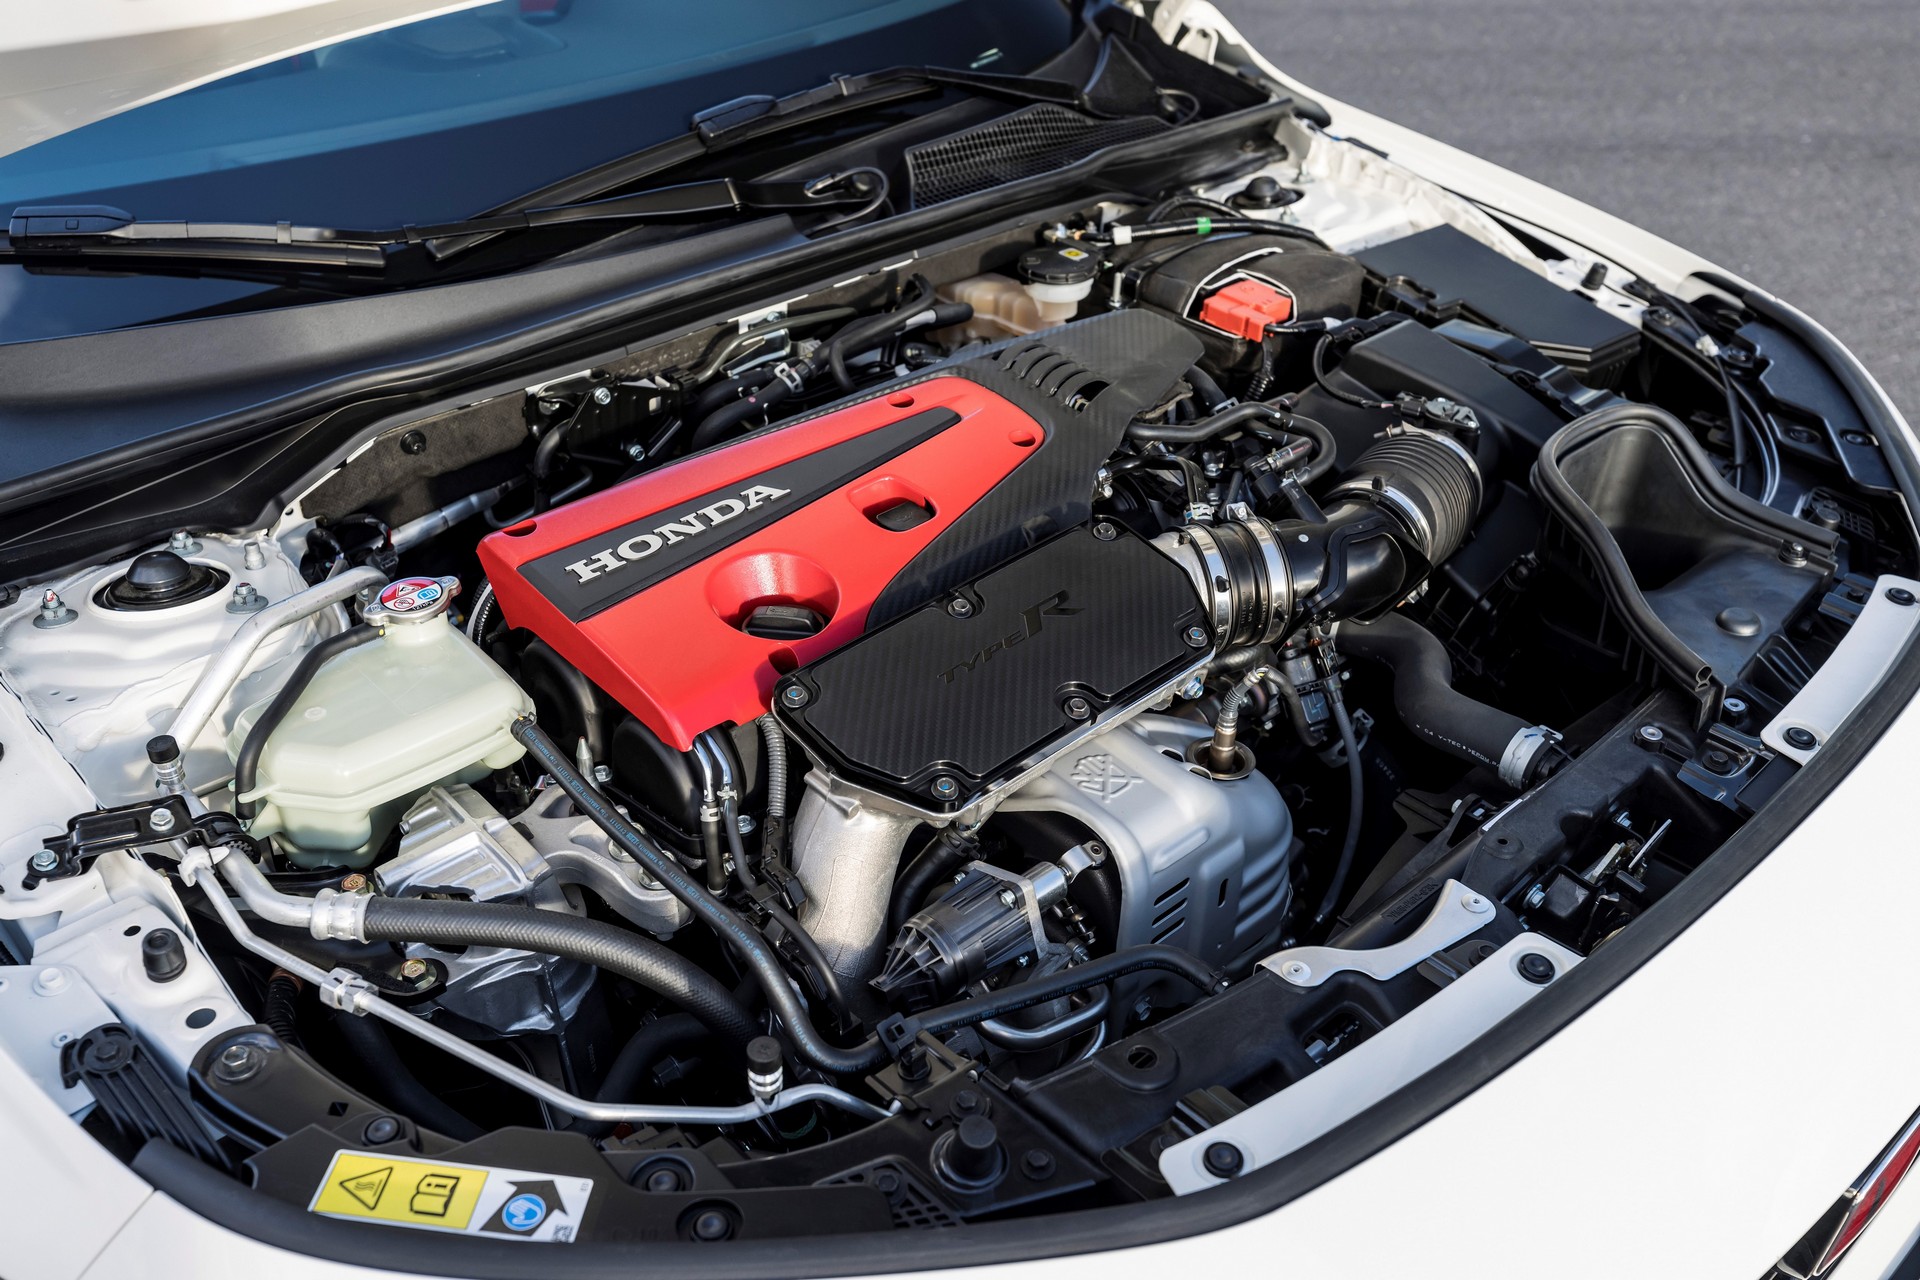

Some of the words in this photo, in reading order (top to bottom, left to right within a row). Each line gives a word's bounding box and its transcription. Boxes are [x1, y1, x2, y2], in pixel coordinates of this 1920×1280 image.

[564, 485, 791, 584] HONDA
[937, 630, 1027, 684] TYPE
[1018, 589, 1086, 638] R
